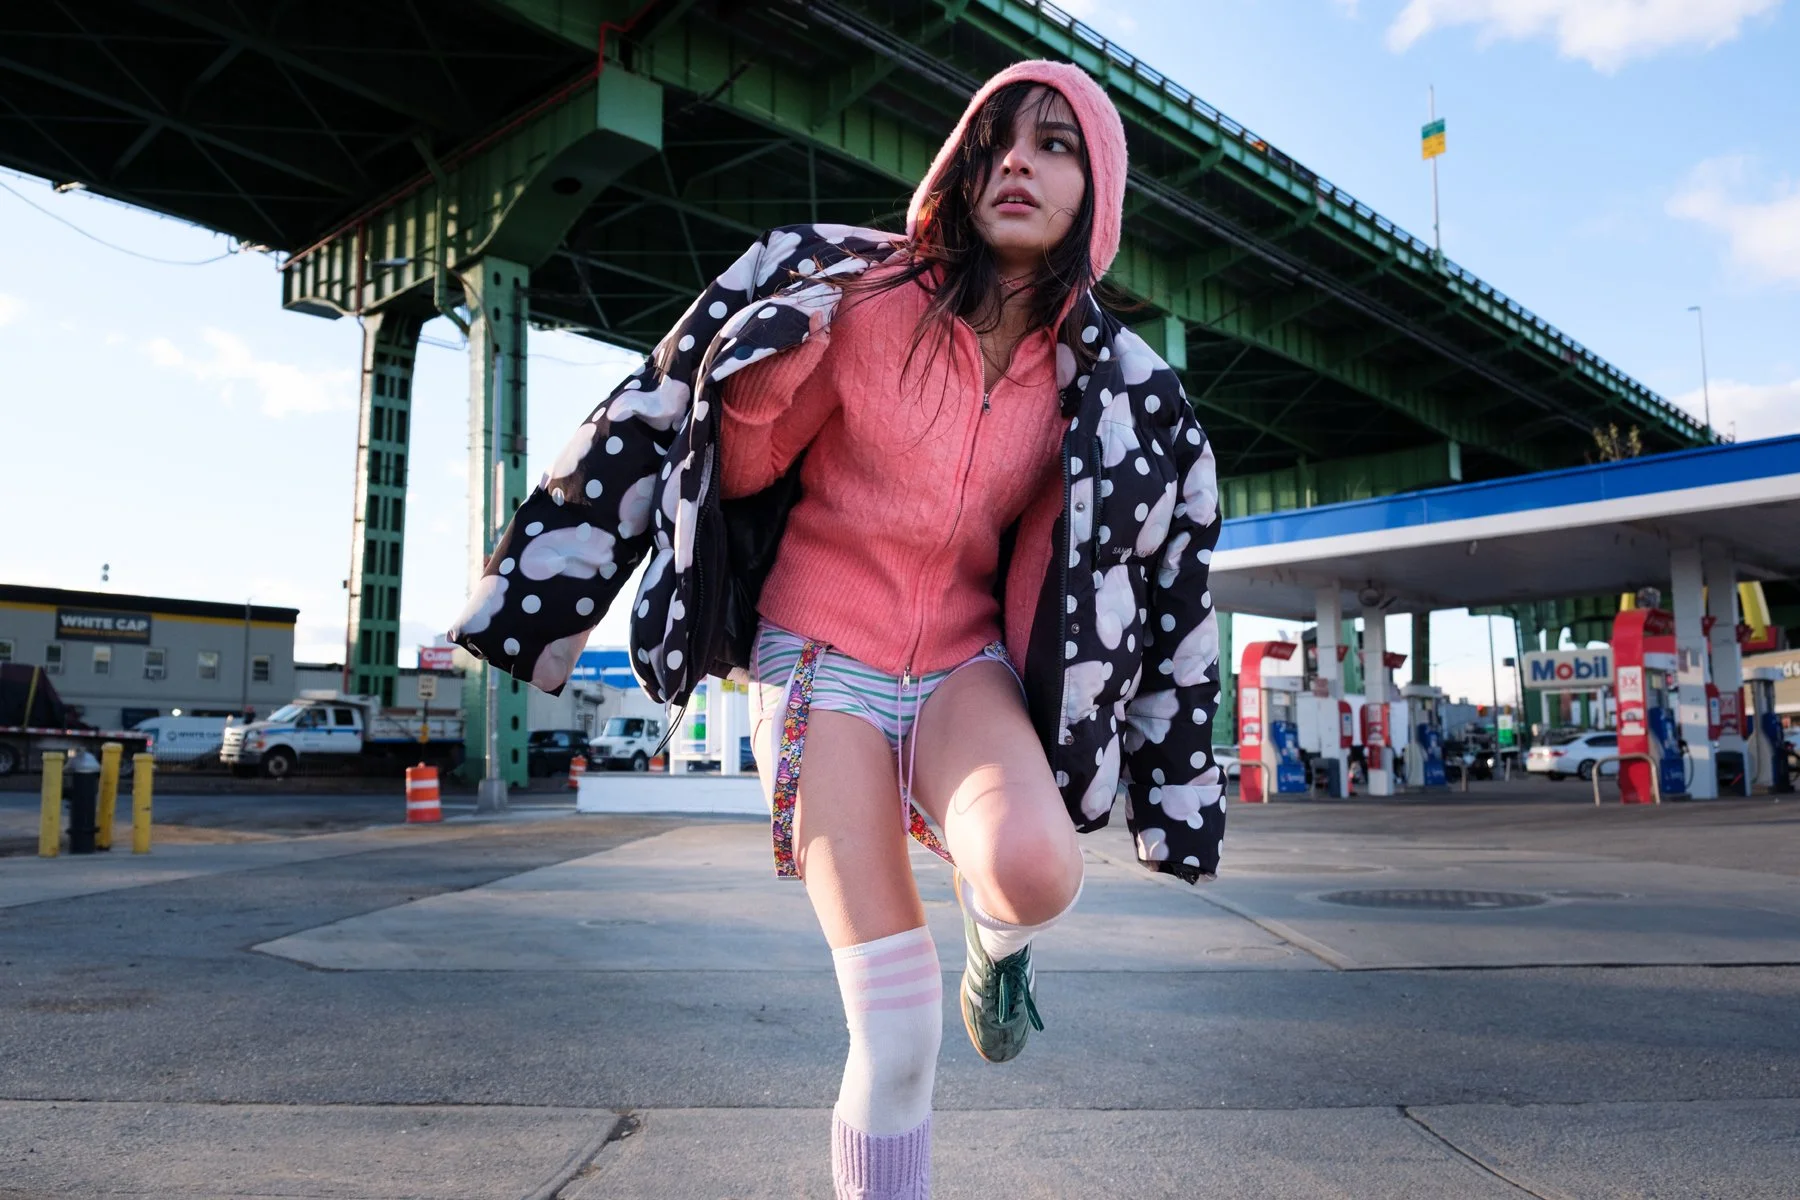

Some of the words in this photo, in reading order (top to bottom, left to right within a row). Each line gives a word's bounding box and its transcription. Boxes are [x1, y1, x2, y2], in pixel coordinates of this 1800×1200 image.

[61, 614, 113, 630] WHITE
[116, 617, 148, 631] CAP
[1531, 656, 1608, 682] Mobil
